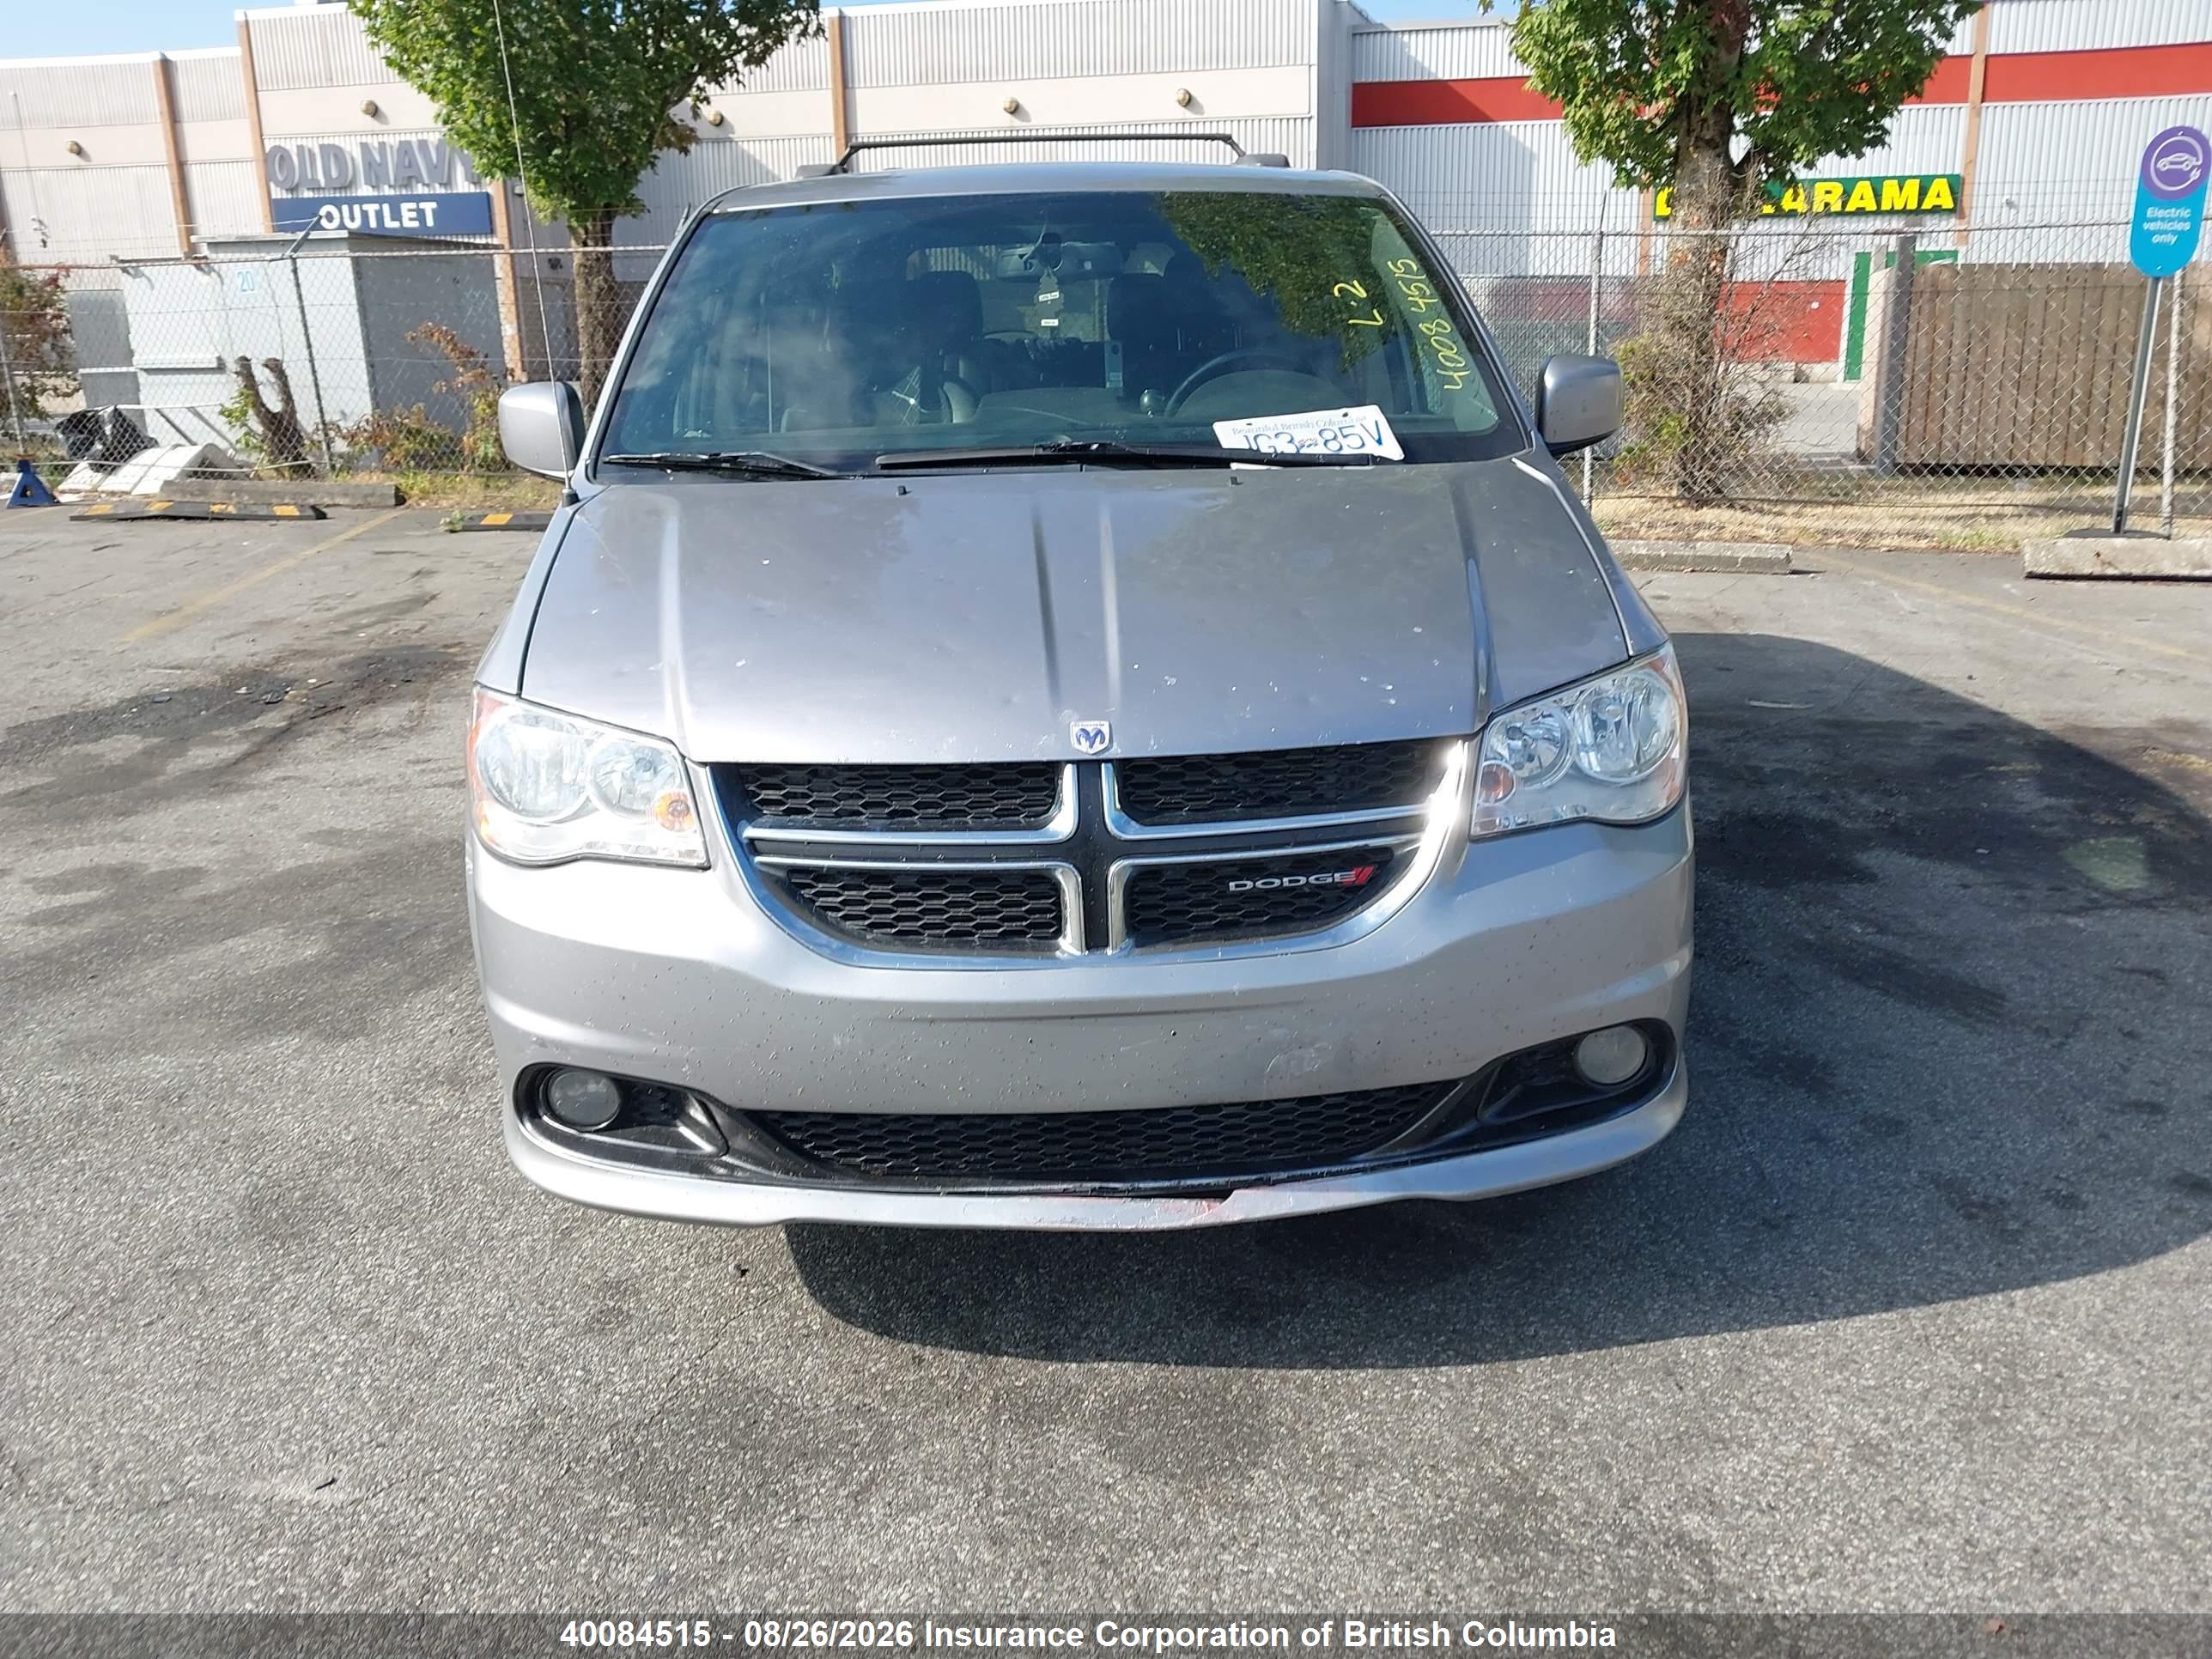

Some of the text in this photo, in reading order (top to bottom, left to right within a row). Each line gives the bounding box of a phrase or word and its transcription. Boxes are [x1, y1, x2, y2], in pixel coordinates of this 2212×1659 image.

[266, 143, 353, 191] OLD
[1656, 178, 1955, 216] ARAMA
[319, 201, 438, 230] OUTLET
[2147, 206, 2191, 218] Electric
[2142, 220, 2191, 231] vehicles
[2151, 233, 2179, 246] only
[1319, 420, 1383, 454] 85V
[1229, 871, 1357, 892] DODGE
